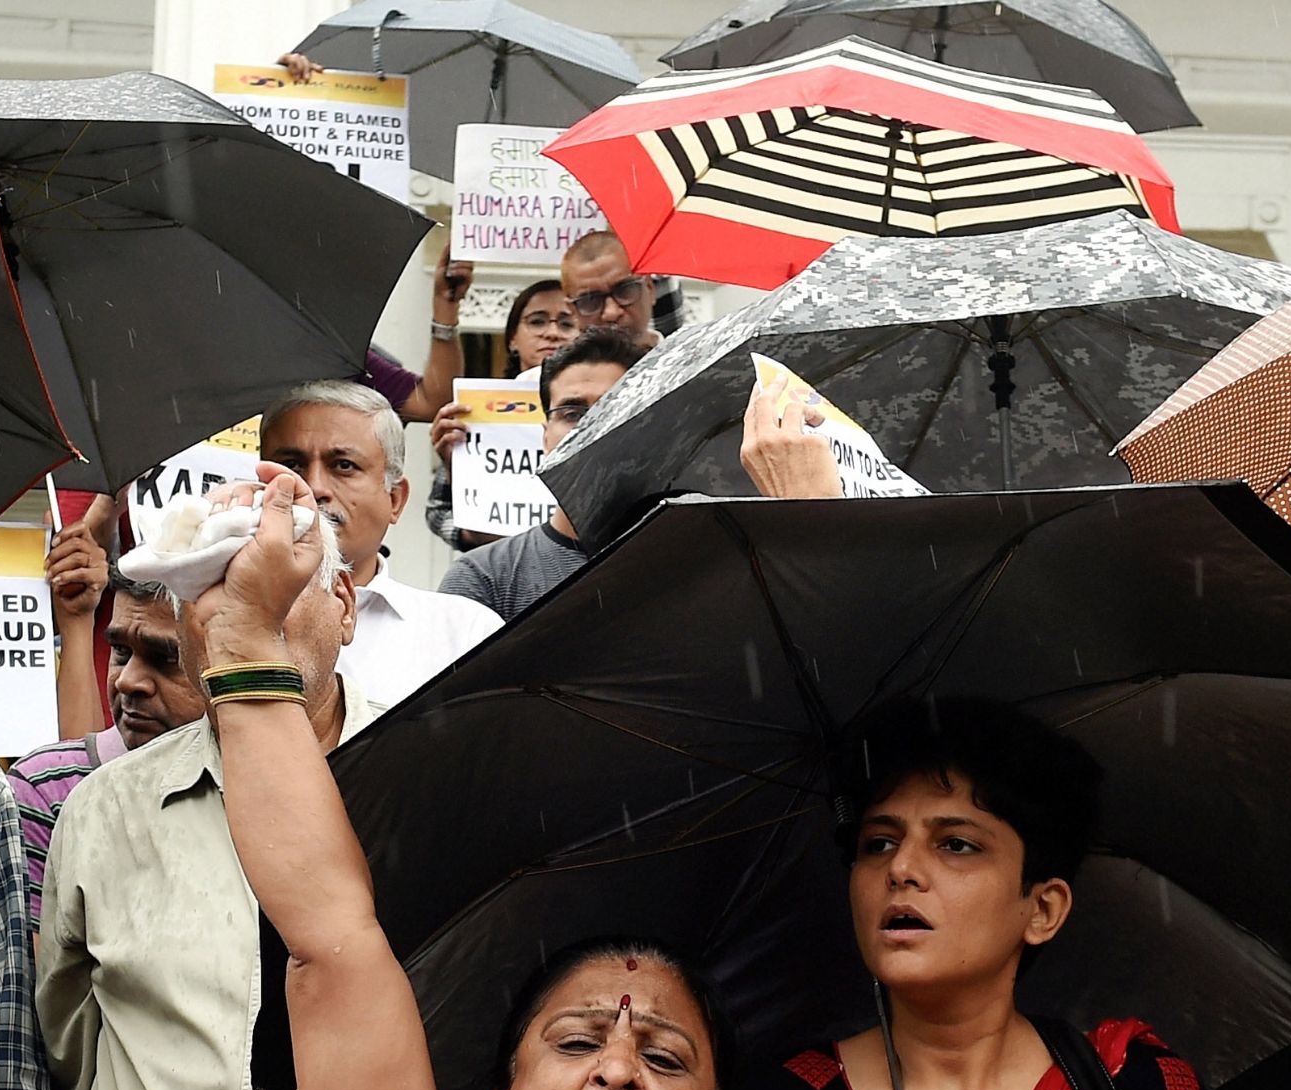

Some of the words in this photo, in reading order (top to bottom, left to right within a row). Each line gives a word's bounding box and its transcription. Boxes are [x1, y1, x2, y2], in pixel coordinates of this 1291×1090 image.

[229, 104, 272, 119] HOM
[279, 108, 300, 120] TO
[307, 109, 329, 122] BE
[334, 111, 402, 128] BLAMED
[264, 123, 320, 139] AUDIT
[326, 128, 338, 140] &
[346, 130, 405, 146] FRAUD
[335, 145, 405, 161] FAILURE
[458, 192, 544, 218] HUMARA
[461, 224, 549, 250] HUMARA
[556, 227, 597, 250] HA
[830, 437, 855, 470] OM
[856, 448, 872, 478] TO
[875, 458, 903, 481] BE
